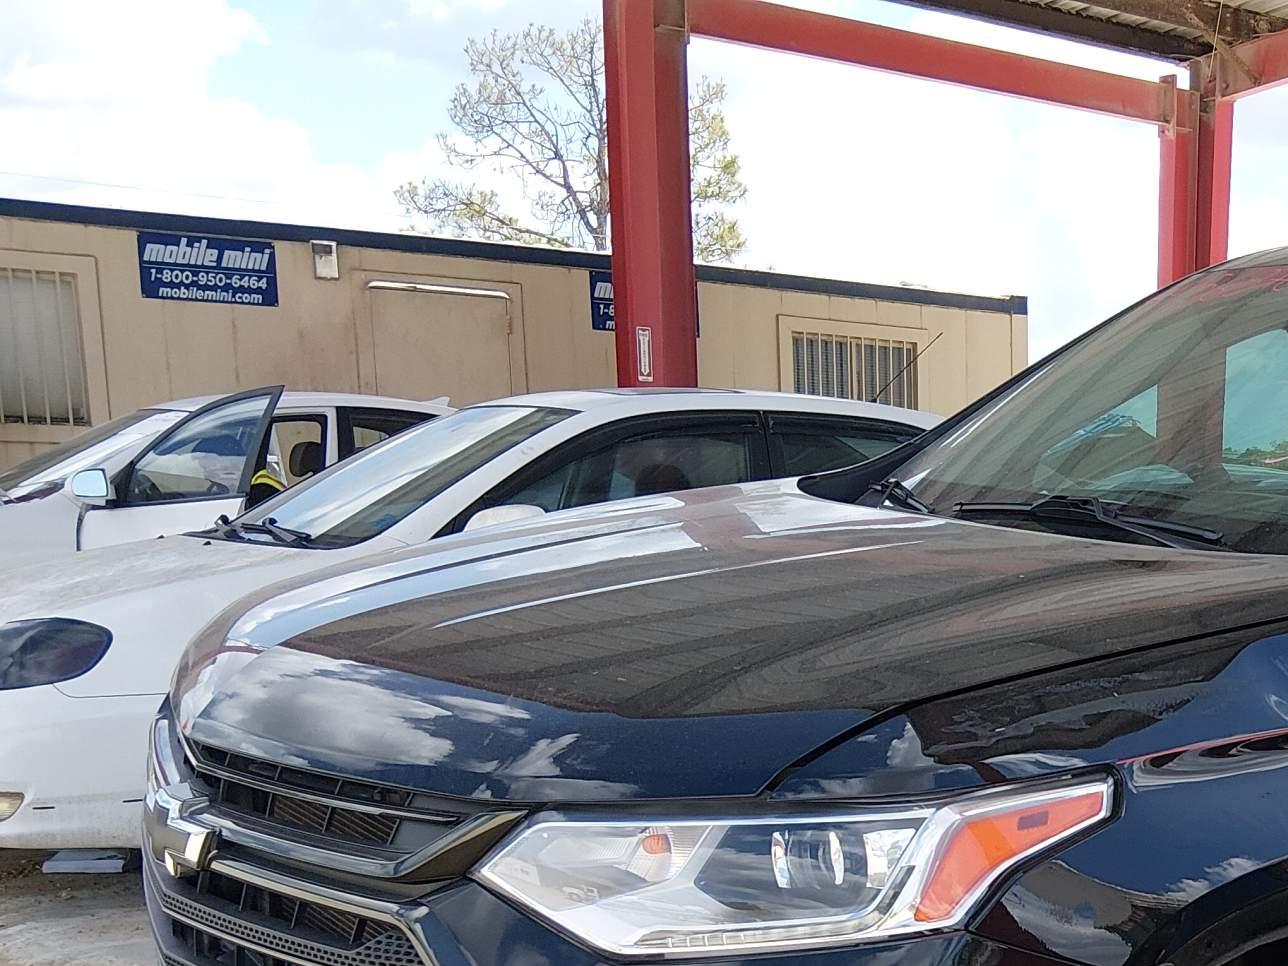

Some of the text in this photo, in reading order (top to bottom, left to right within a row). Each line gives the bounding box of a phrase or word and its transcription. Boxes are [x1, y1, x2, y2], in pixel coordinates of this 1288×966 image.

[143, 237, 271, 271] mobile mini
[149, 268, 268, 290] 1-800-950-6464
[158, 286, 263, 304] mobilemini.com
